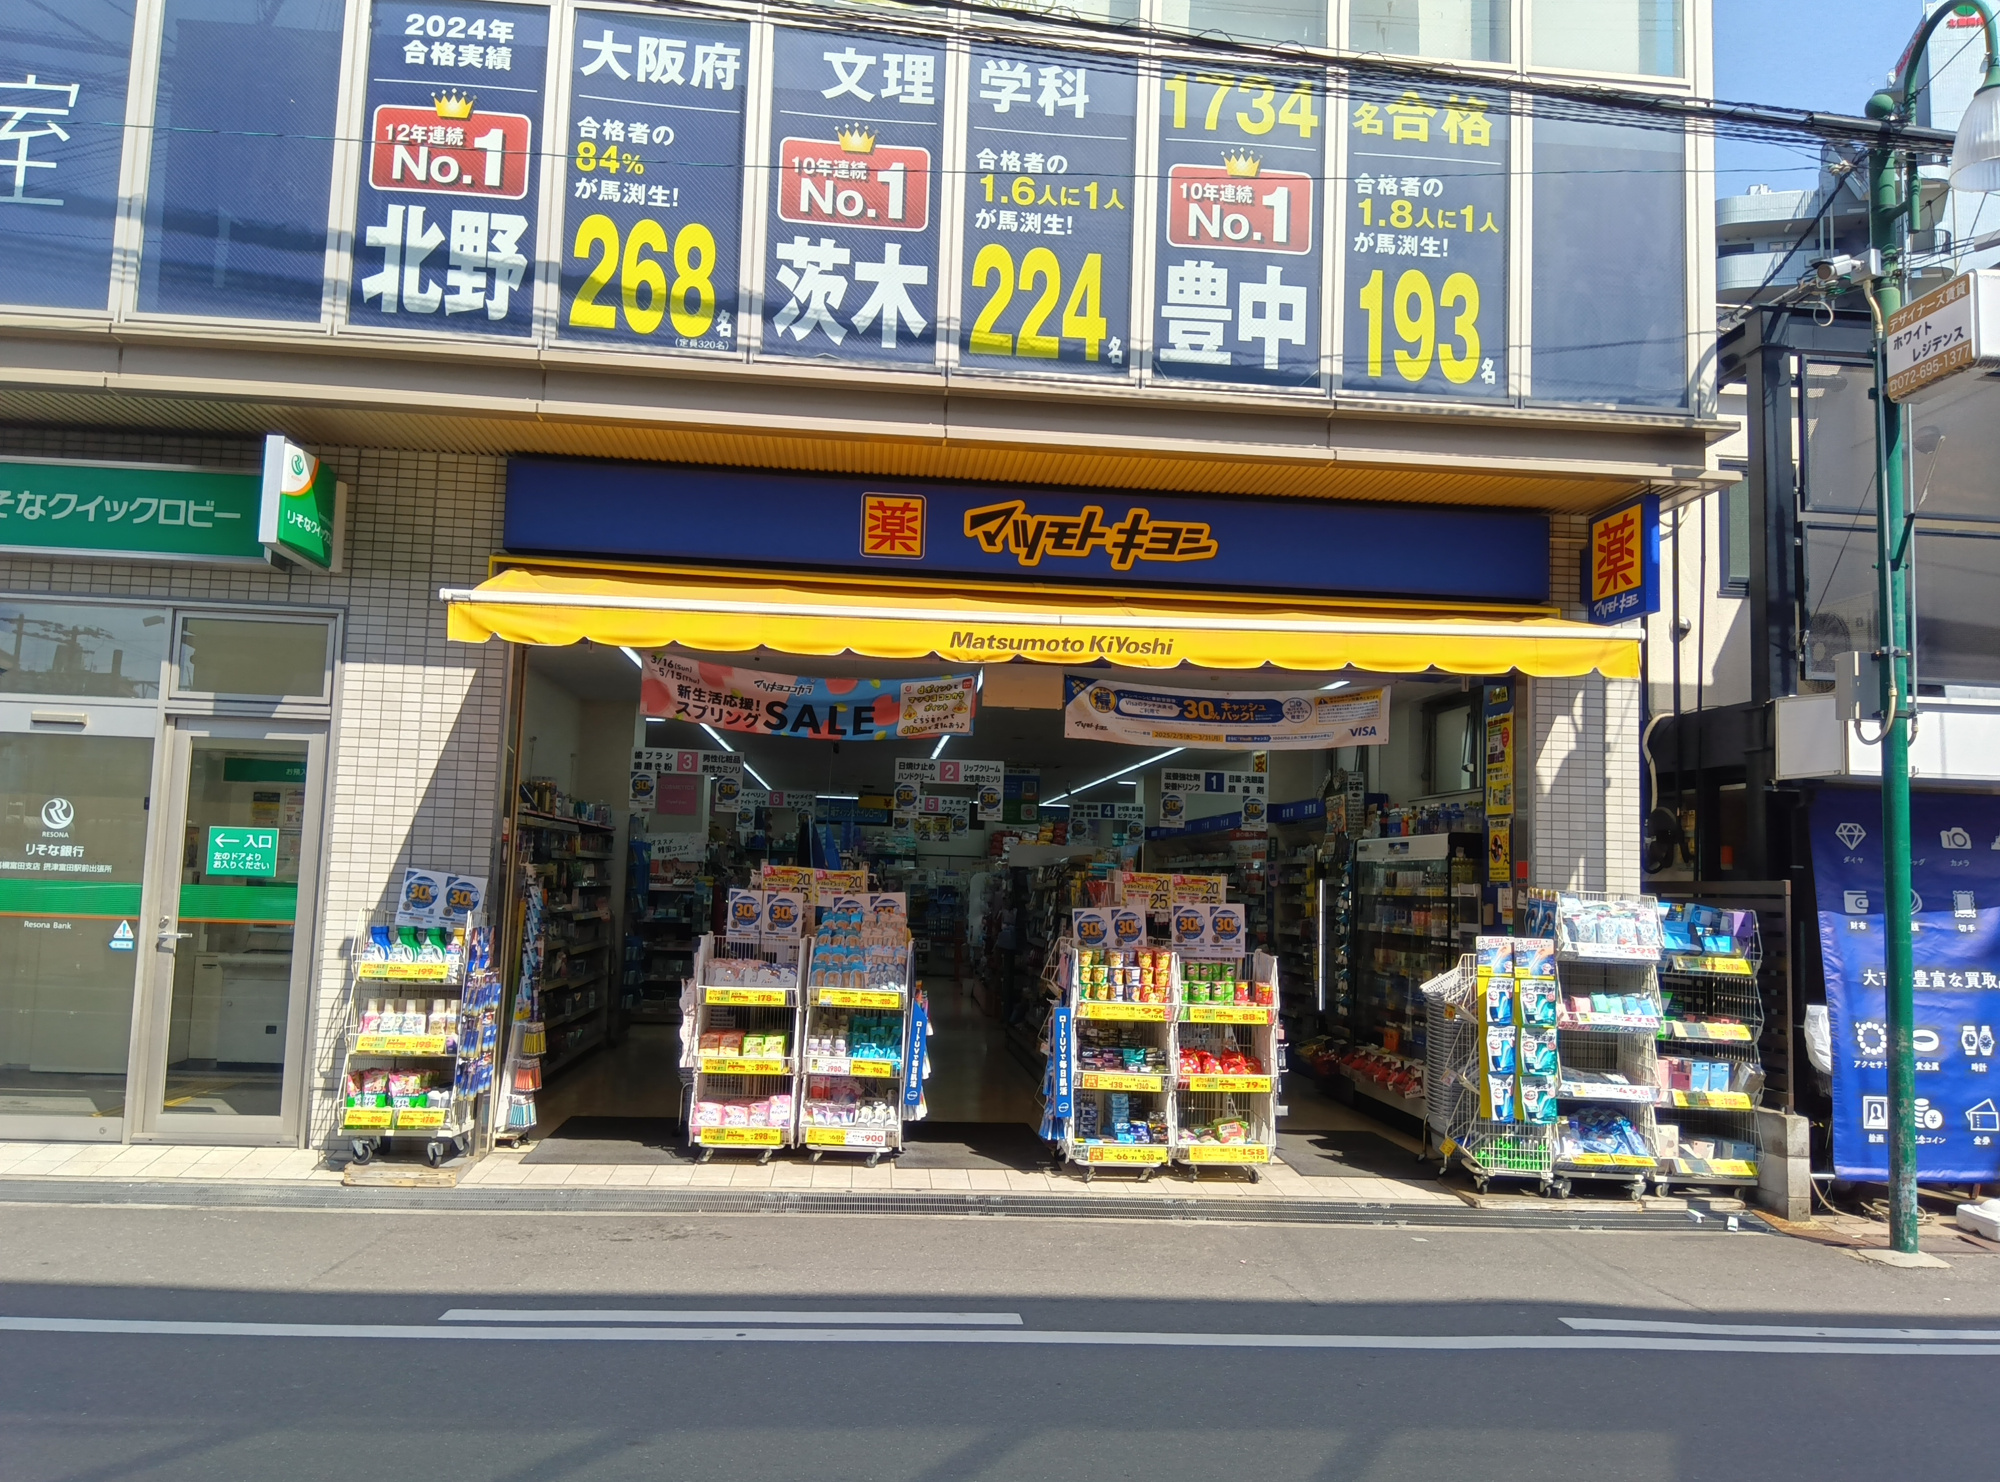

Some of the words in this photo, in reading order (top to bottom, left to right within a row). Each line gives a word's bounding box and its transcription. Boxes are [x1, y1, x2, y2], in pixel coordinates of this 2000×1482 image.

[404, 14, 515, 42] 2024年
[403, 40, 512, 71] 合格実績
[580, 31, 741, 91] 大阪府
[821, 47, 935, 104] 文理
[980, 59, 1089, 119] 学科
[1164, 72, 1318, 138] 1734
[1353, 92, 1492, 146] 名合格
[384, 123, 465, 147] 12年連続
[577, 117, 675, 147] 合格者の
[392, 128, 506, 188] No.1
[575, 142, 644, 176] 84%
[791, 156, 867, 182] 10年連続
[976, 149, 1068, 174] 合格者の
[575, 178, 680, 209] が馬渕生!
[800, 162, 906, 220] No.1
[983, 175, 1125, 210] 1.6人に1人
[1179, 183, 1253, 204] 10年連続
[1354, 173, 1444, 198] 合格者の
[975, 209, 1073, 236] が馬渕生!
[1188, 186, 1289, 243] No.1
[1358, 198, 1499, 234] 1.8人に1人
[1354, 233, 1449, 258] が馬渕生!
[362, 204, 529, 320] 北野
[774, 237, 928, 348] 茨木
[1160, 260, 1307, 370] 豊中
[1889, 281, 1966, 332] デザイナーズ賃貸
[1893, 321, 1932, 350] ホワイト
[1912, 326, 1964, 362] レジデンス
[868, 501, 918, 553] 薬
[966, 503, 1216, 568] マツモトキヨシ
[1597, 513, 1635, 595] 薬
[1593, 592, 1639, 619] マツモトキヨシ
[949, 631, 1085, 653] Matsumoto
[1089, 635, 1174, 656] KiYoshi
[677, 684, 760, 711] 新生活応援!
[1183, 700, 1221, 720] 30%
[675, 701, 760, 728] スプリング
[763, 700, 875, 736] SALE
[1350, 726, 1376, 737] VISA
[682, 754, 692, 769] 3
[945, 764, 955, 779] 2
[963, 764, 1000, 773] リップクリーム
[898, 773, 936, 781] ハンドクリーム
[1210, 775, 1217, 789] 1
[773, 793, 780, 804] 6
[928, 798, 935, 809] 5
[1104, 805, 1111, 817] 4
[26, 843, 85, 857] りそな銀行
[244, 834, 272, 848] 入口
[213, 852, 262, 860] 左のドアより
[213, 860, 270, 869] お入りください
[1910, 858, 1926, 866] ッグ
[1950, 859, 1970, 867] カメラ
[24, 920, 50, 929] Resona
[53, 921, 71, 930] Bank
[1850, 921, 1867, 930] 財布
[1957, 924, 1976, 933] 切手
[1971, 1063, 1987, 1072] 時計
[864, 1134, 884, 1142] 900
